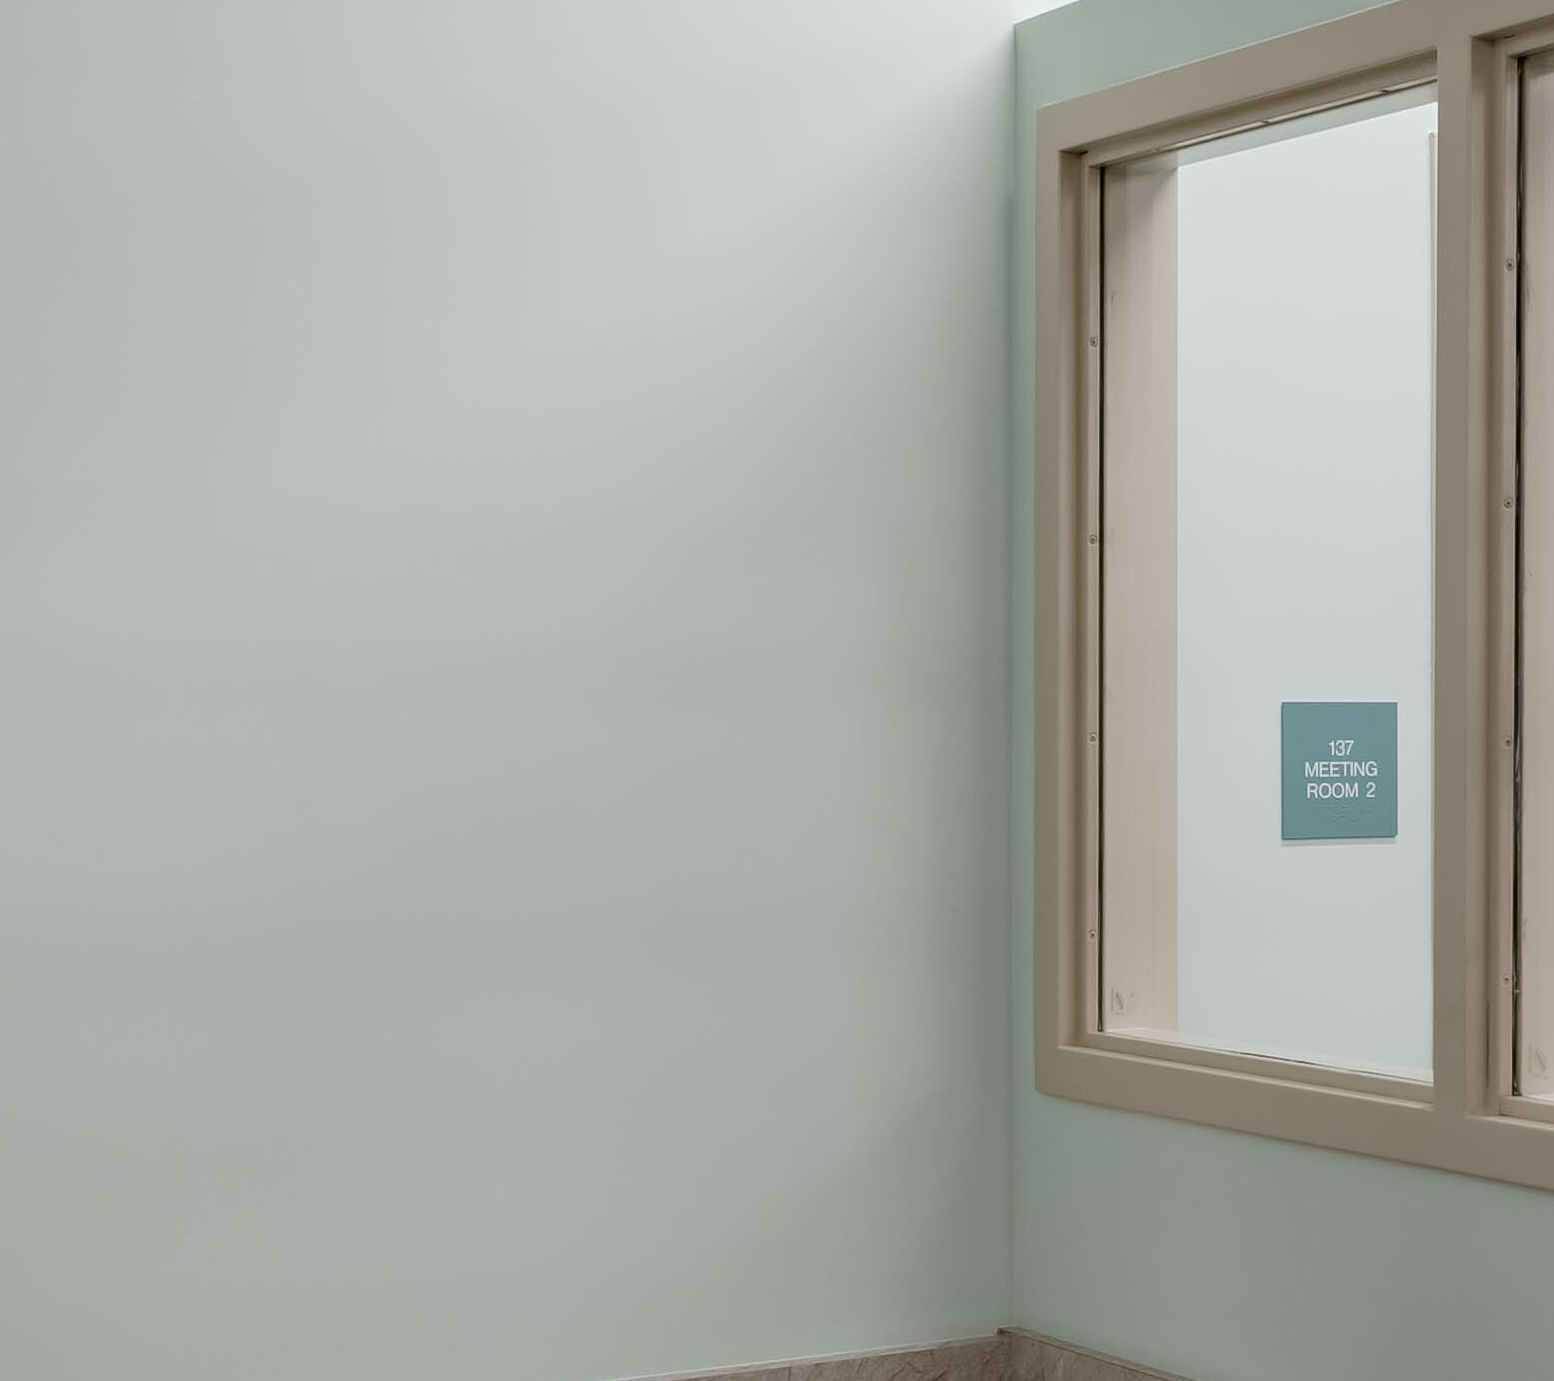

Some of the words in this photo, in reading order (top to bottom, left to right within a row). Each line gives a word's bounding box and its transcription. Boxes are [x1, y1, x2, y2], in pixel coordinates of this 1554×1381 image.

[1328, 739, 1354, 756] 137
[1304, 761, 1378, 778] MEETING
[1306, 782, 1359, 799] ROOM
[1365, 782, 1376, 798] 2
